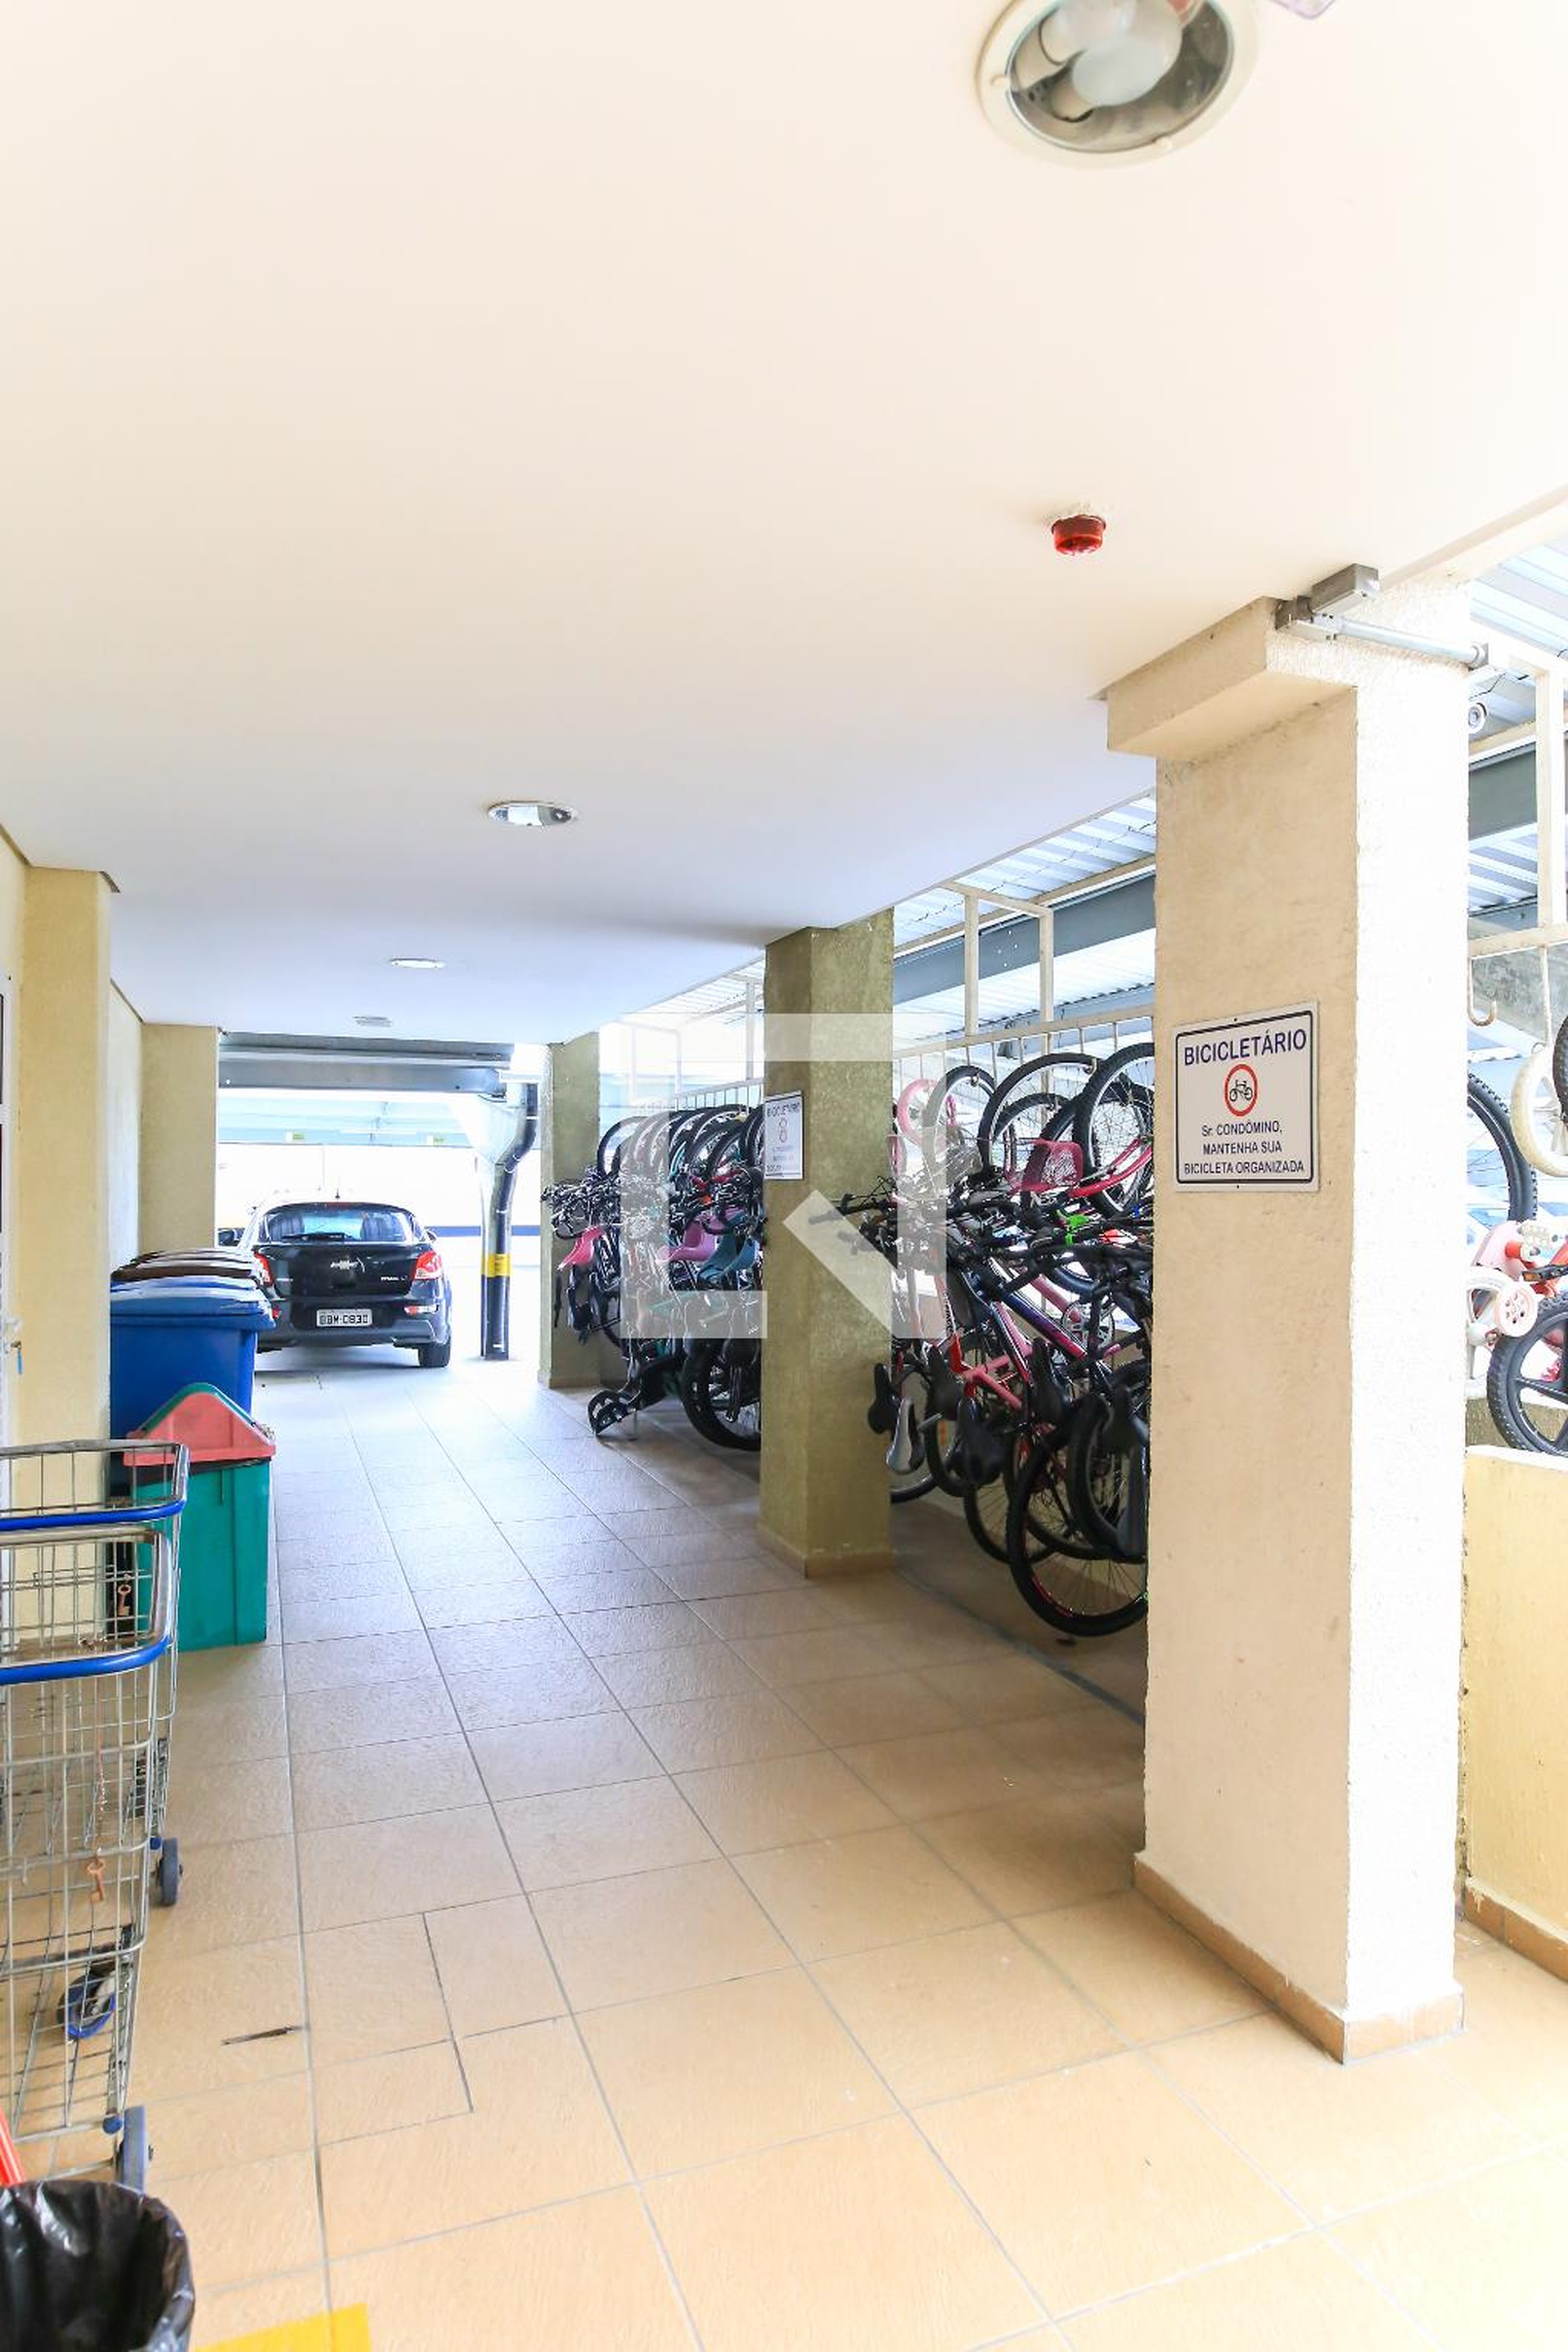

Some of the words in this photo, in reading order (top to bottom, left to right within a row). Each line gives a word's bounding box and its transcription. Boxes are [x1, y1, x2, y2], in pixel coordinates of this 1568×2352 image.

[1185, 1029, 1306, 1066] BICICLETÁRIO
[1203, 1142, 1258, 1155] MANTENHA
[1261, 1140, 1282, 1154] SUA
[1184, 1161, 1233, 1174] BICICLETA
[1235, 1160, 1304, 1174] ORGANIZADA
